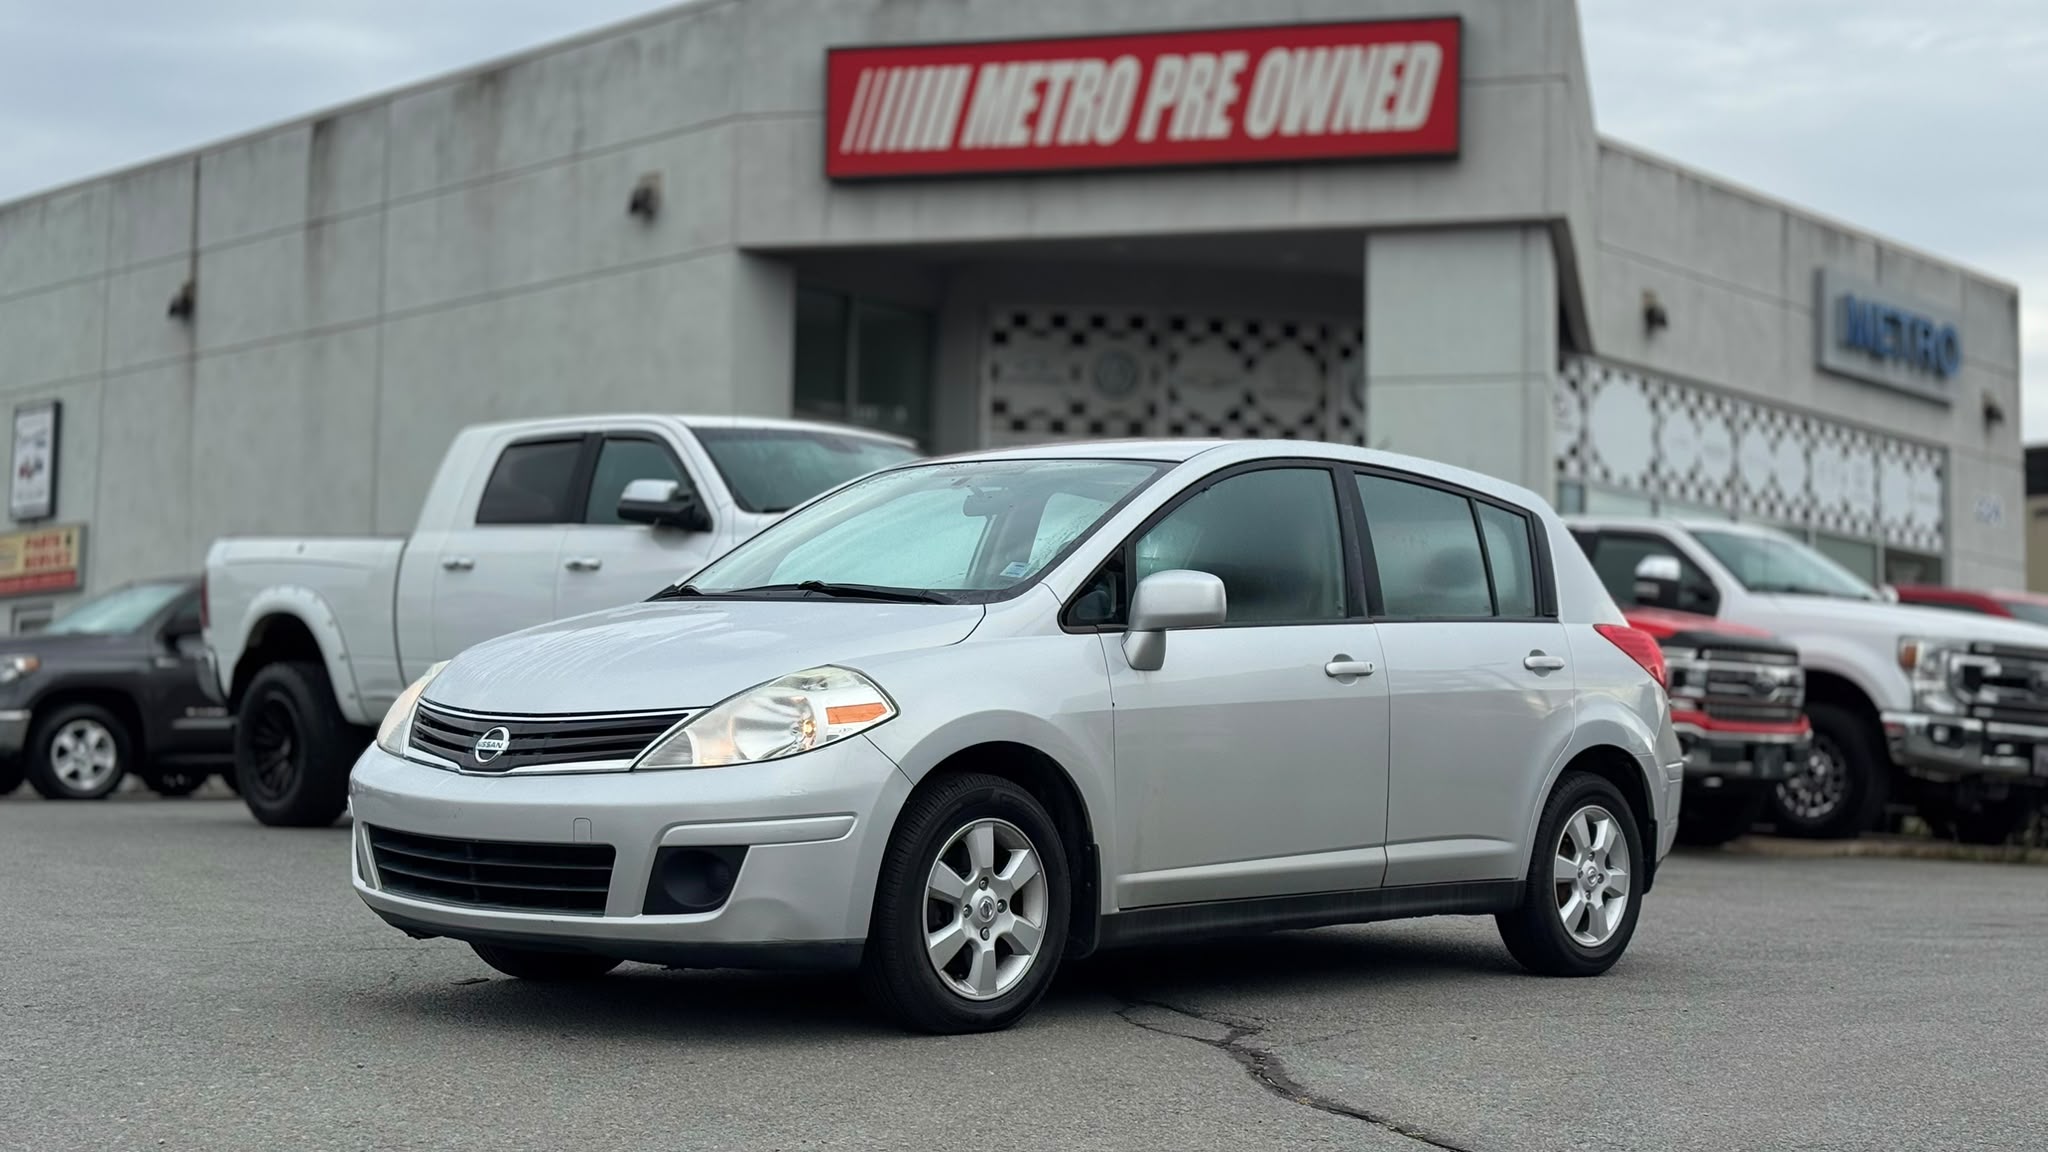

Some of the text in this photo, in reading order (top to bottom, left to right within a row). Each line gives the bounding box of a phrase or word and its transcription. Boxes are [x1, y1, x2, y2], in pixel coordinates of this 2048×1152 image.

[960, 41, 1443, 149] METRO PRE OWNED
[1843, 294, 1963, 378] METRO
